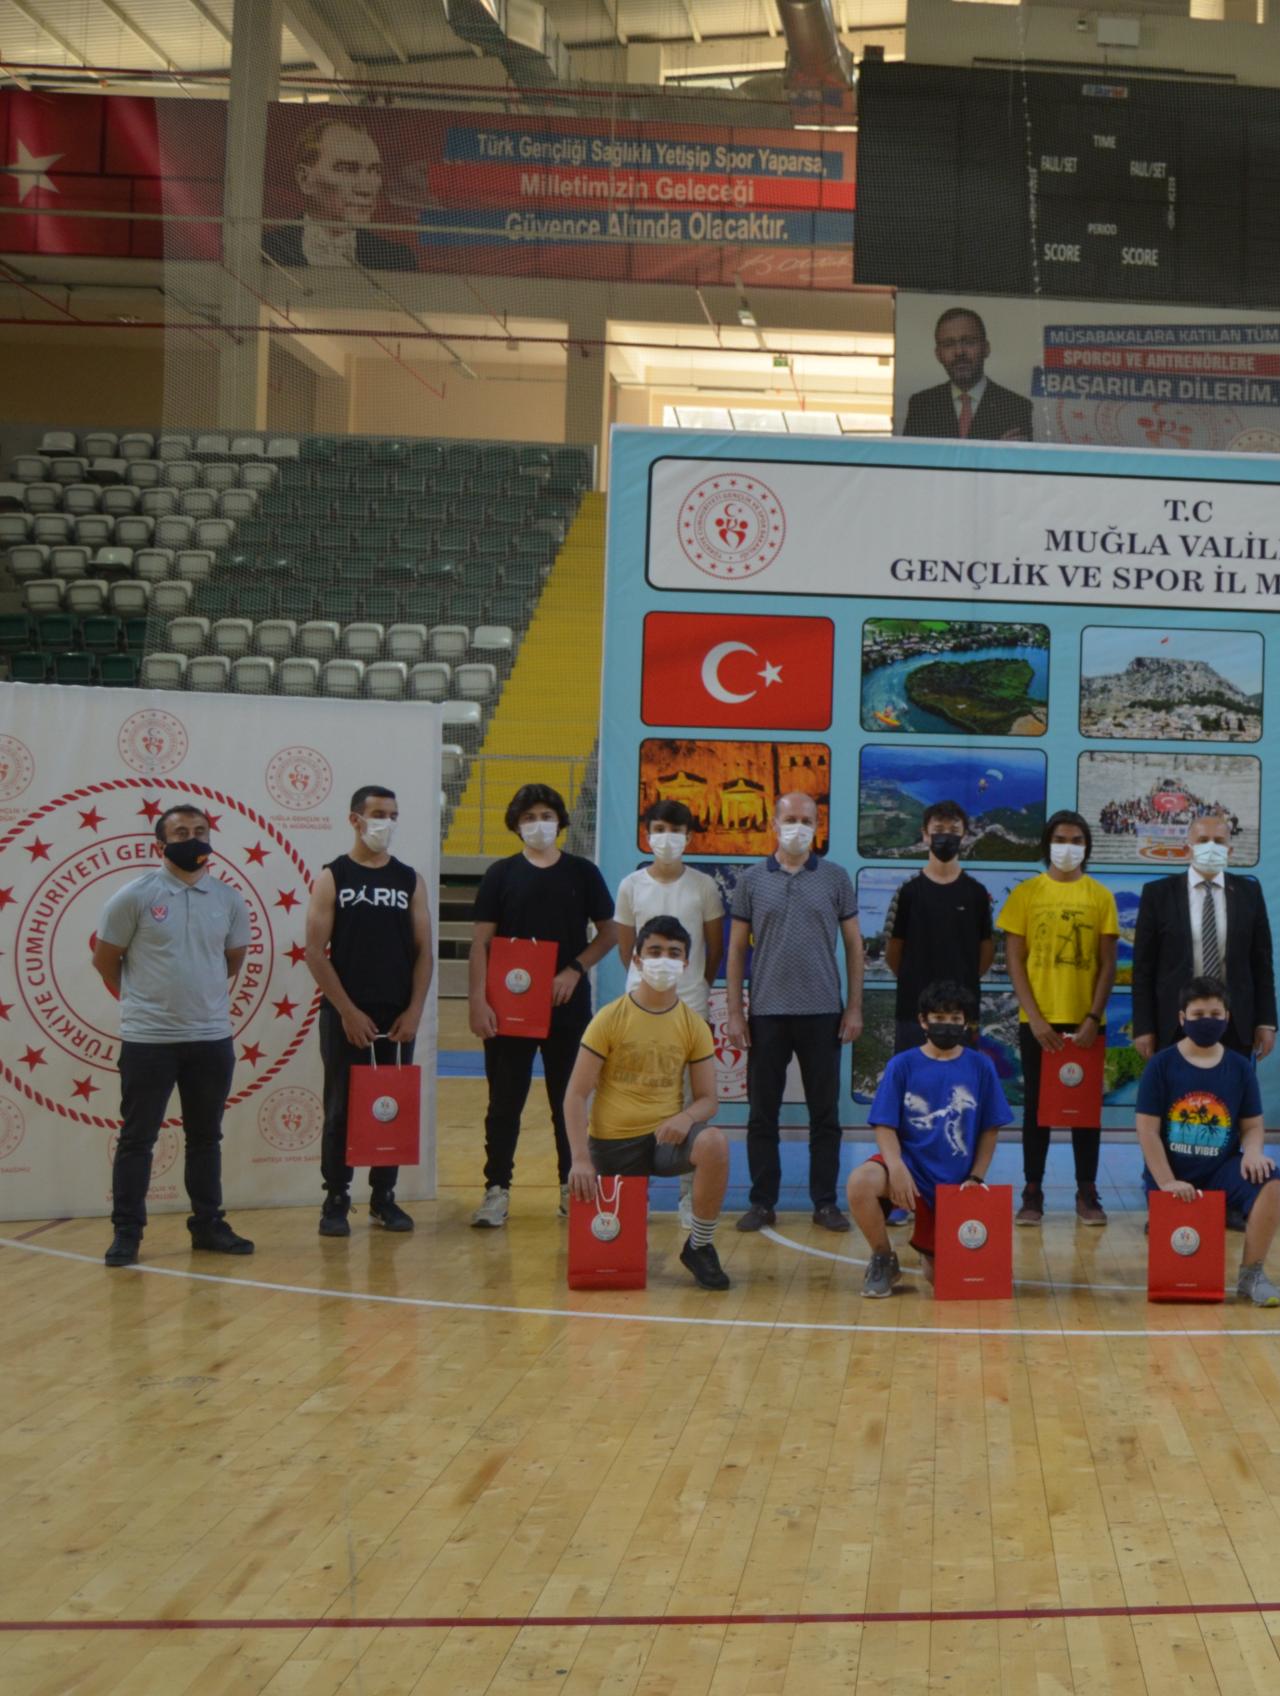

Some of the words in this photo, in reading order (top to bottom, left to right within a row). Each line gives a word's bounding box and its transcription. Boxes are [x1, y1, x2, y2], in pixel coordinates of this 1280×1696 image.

[477, 133, 514, 158] Türk
[519, 135, 587, 165] Gençliği
[591, 139, 652, 168] Sağlıklı
[656, 143, 711, 172] Yetişip
[714, 146, 753, 173] Spor
[758, 148, 828, 177] Yaparsa,
[1092, 134, 1118, 150] TIME
[520, 173, 649, 200] Milletimizin
[655, 176, 755, 208] Geleceği
[505, 212, 601, 241] Güvence
[606, 212, 682, 241] Altında
[688, 212, 789, 242] Olacaktır.
[1043, 243, 1082, 262] SCORE
[1121, 247, 1160, 267] SCORE
[1049, 327, 1176, 345] MÜSABAKALARA
[1179, 328, 1241, 343] KATILAN
[1246, 325, 1280, 342] TÜM
[1063, 350, 1122, 368] SPORCU
[1126, 352, 1143, 368] VE
[1146, 352, 1256, 372] ANTRENÖRLERE
[1046, 374, 1172, 400] BAŞARILAR
[1179, 376, 1279, 403] DİLERİM.
[1164, 499, 1214, 524] T.C
[1044, 524, 1171, 556] MUĞLA
[889, 556, 1050, 591] GENÇLİK
[1057, 564, 1102, 589] VE
[1112, 566, 1204, 593] SPOR
[1213, 562, 1248, 596] İL
[338, 885, 410, 910] PARIS
[25, 847, 111, 986] CUMHURİYETİ
[34, 991, 114, 1062] TÜRKİYE
[1169, 1142, 1193, 1155] CHILL
[1194, 1144, 1221, 1157] VIBES
